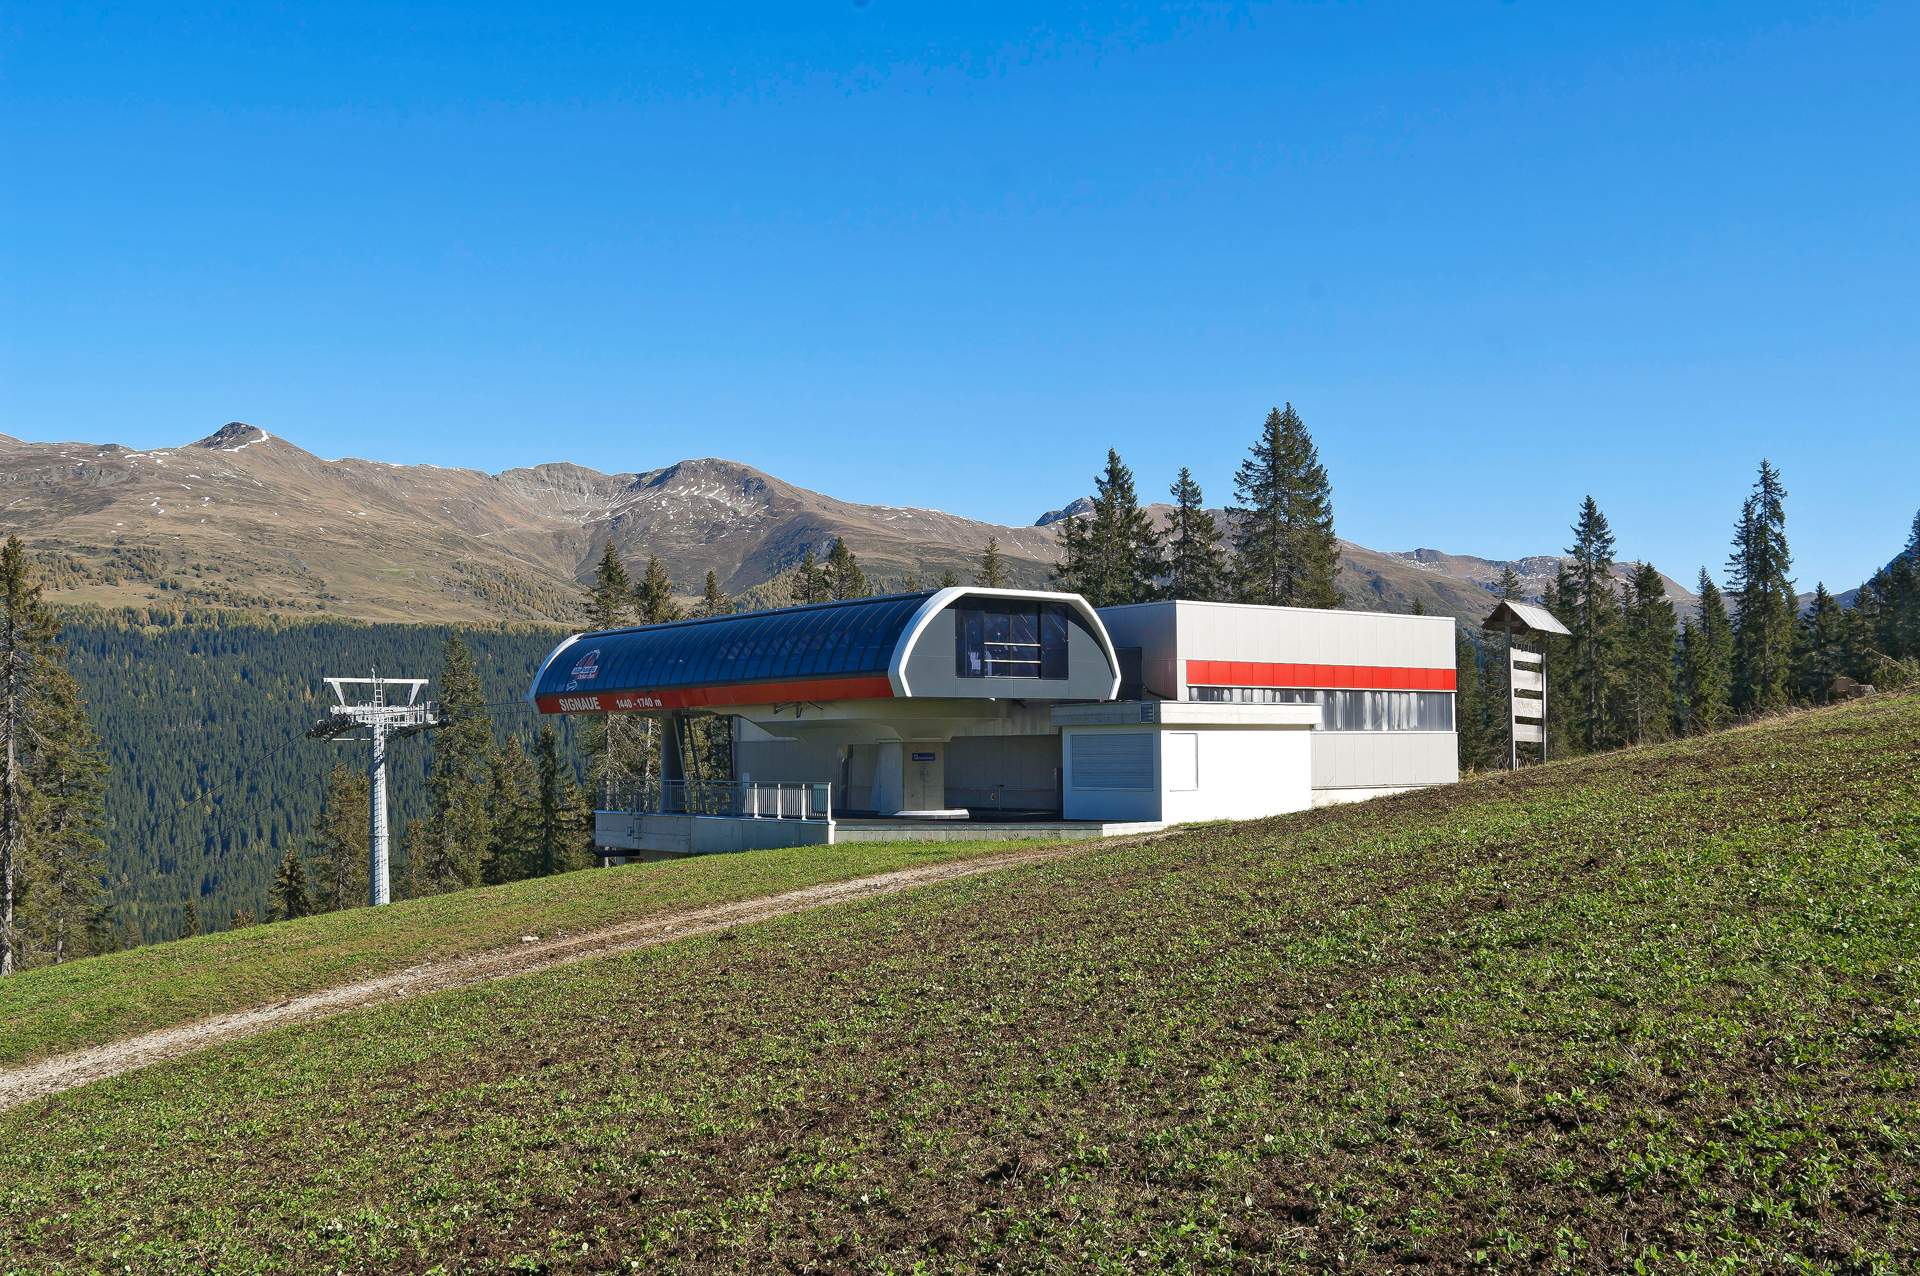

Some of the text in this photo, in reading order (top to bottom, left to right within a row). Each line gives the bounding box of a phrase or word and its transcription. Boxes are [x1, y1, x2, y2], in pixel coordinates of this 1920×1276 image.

[560, 696, 600, 711] SIGNAUE
[616, 699, 632, 709] 1440
[637, 698, 653, 708] 1740
[654, 698, 662, 707] m
